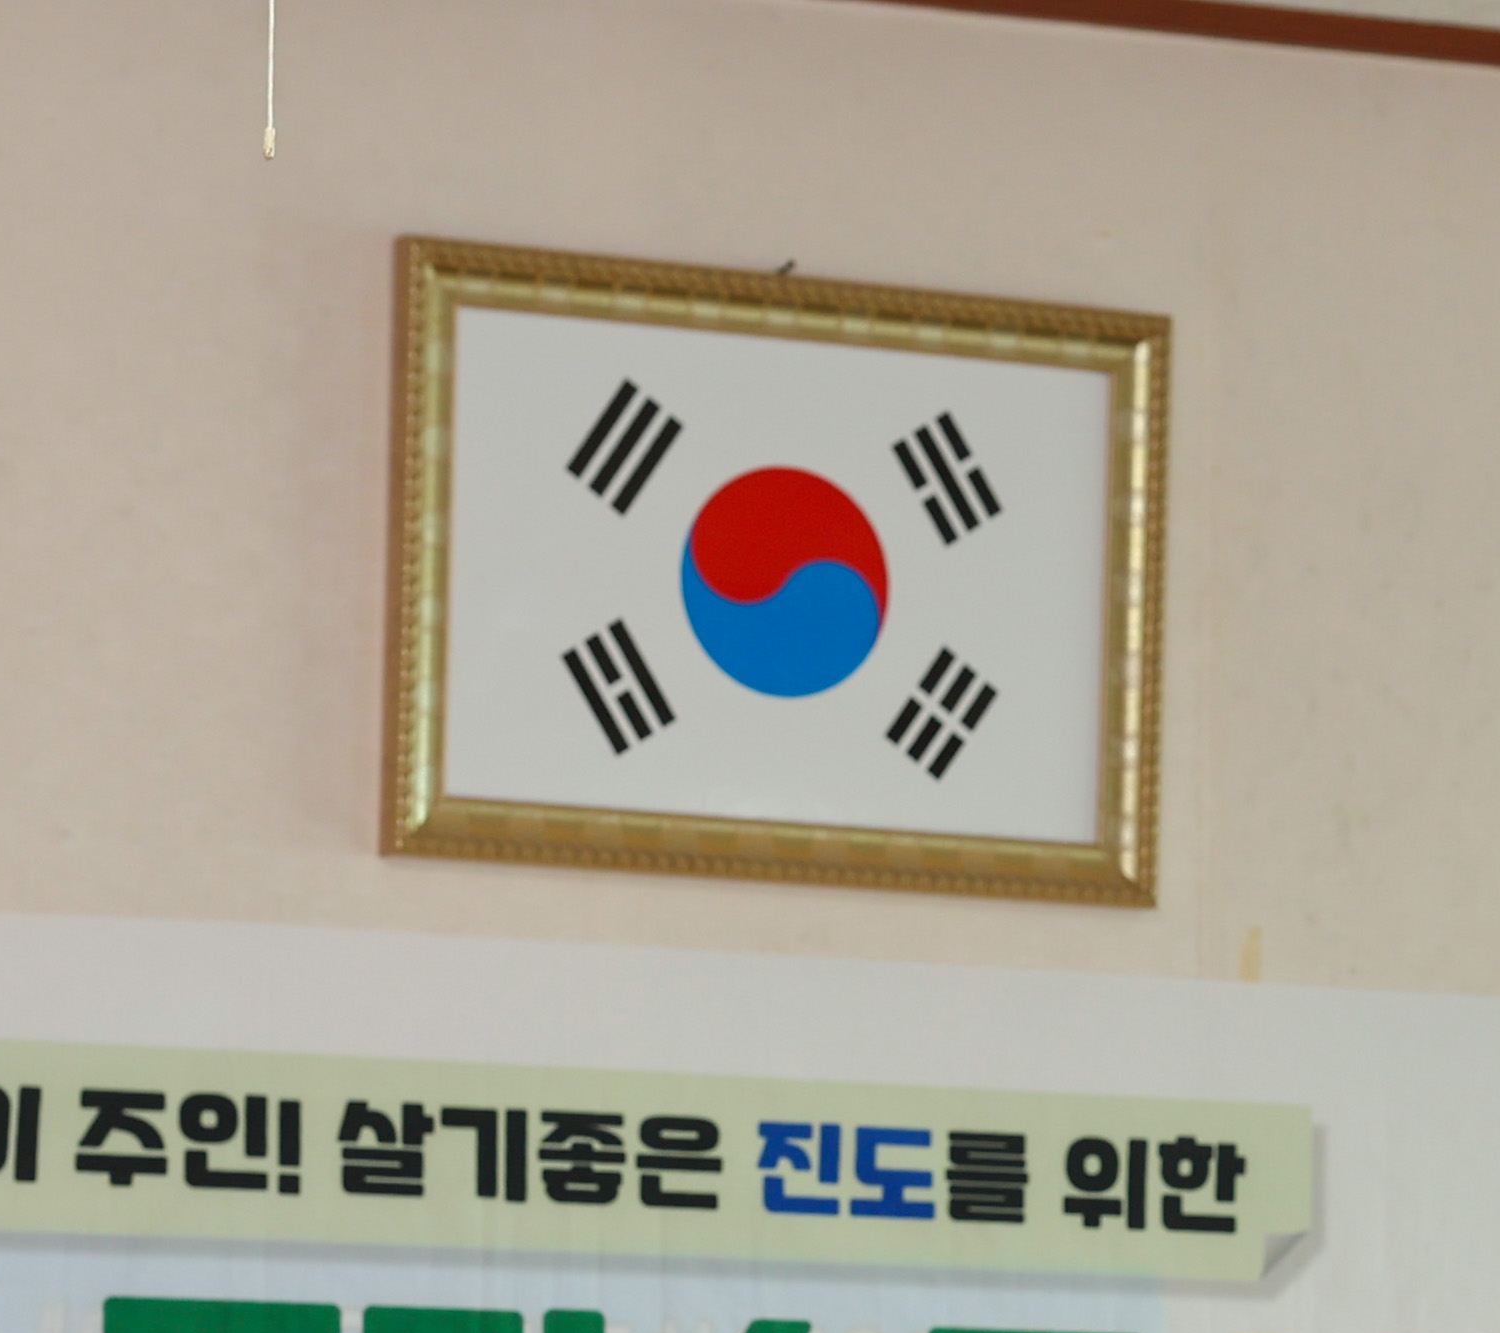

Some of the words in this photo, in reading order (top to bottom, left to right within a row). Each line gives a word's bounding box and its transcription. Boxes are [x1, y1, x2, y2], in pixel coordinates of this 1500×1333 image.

[76, 1091, 301, 1195] 주인!
[339, 1101, 722, 1212] 살기좋은
[760, 1119, 1027, 1226] 진도를
[1064, 1135, 1245, 1235] 위한
